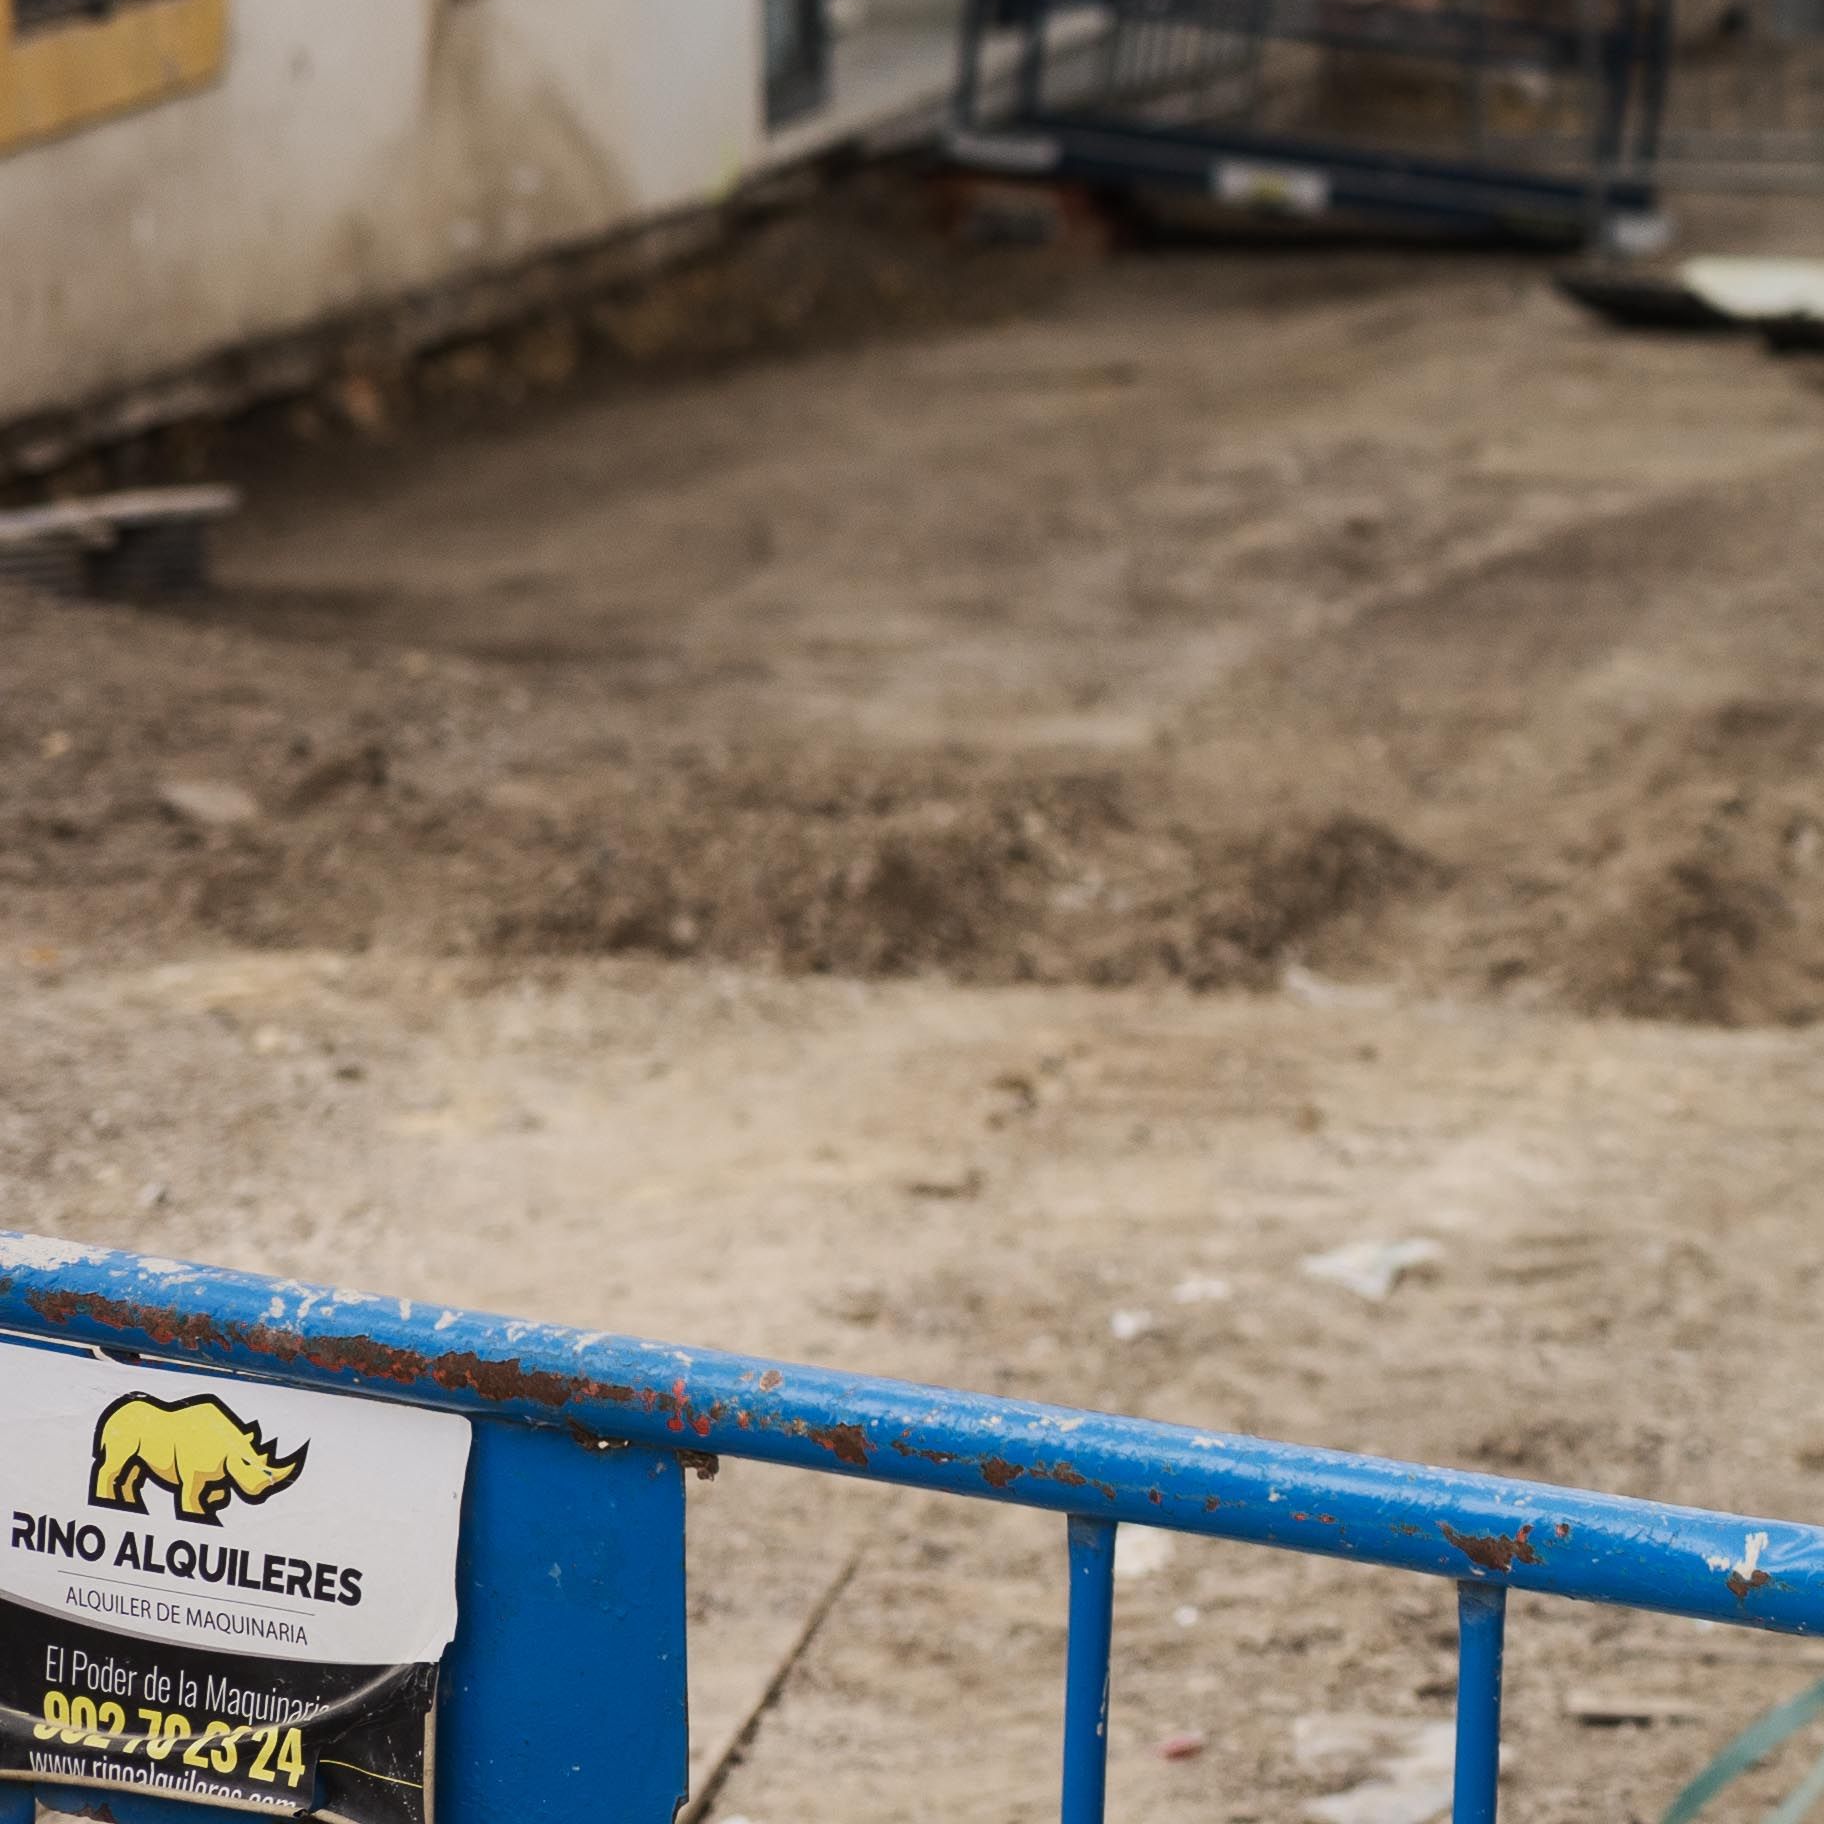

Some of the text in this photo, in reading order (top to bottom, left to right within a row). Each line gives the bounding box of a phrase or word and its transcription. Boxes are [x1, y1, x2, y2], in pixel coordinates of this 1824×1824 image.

[11, 1511, 364, 1607] RINO ALQUILERES
[65, 1586, 308, 1646] ALQUILER DE MAQUINARIA
[45, 1645, 64, 1683] El
[72, 1650, 138, 1697] Poder
[144, 1665, 171, 1704] de
[178, 1670, 197, 1709] la
[33, 1690, 306, 1788] 902 70 23 24
